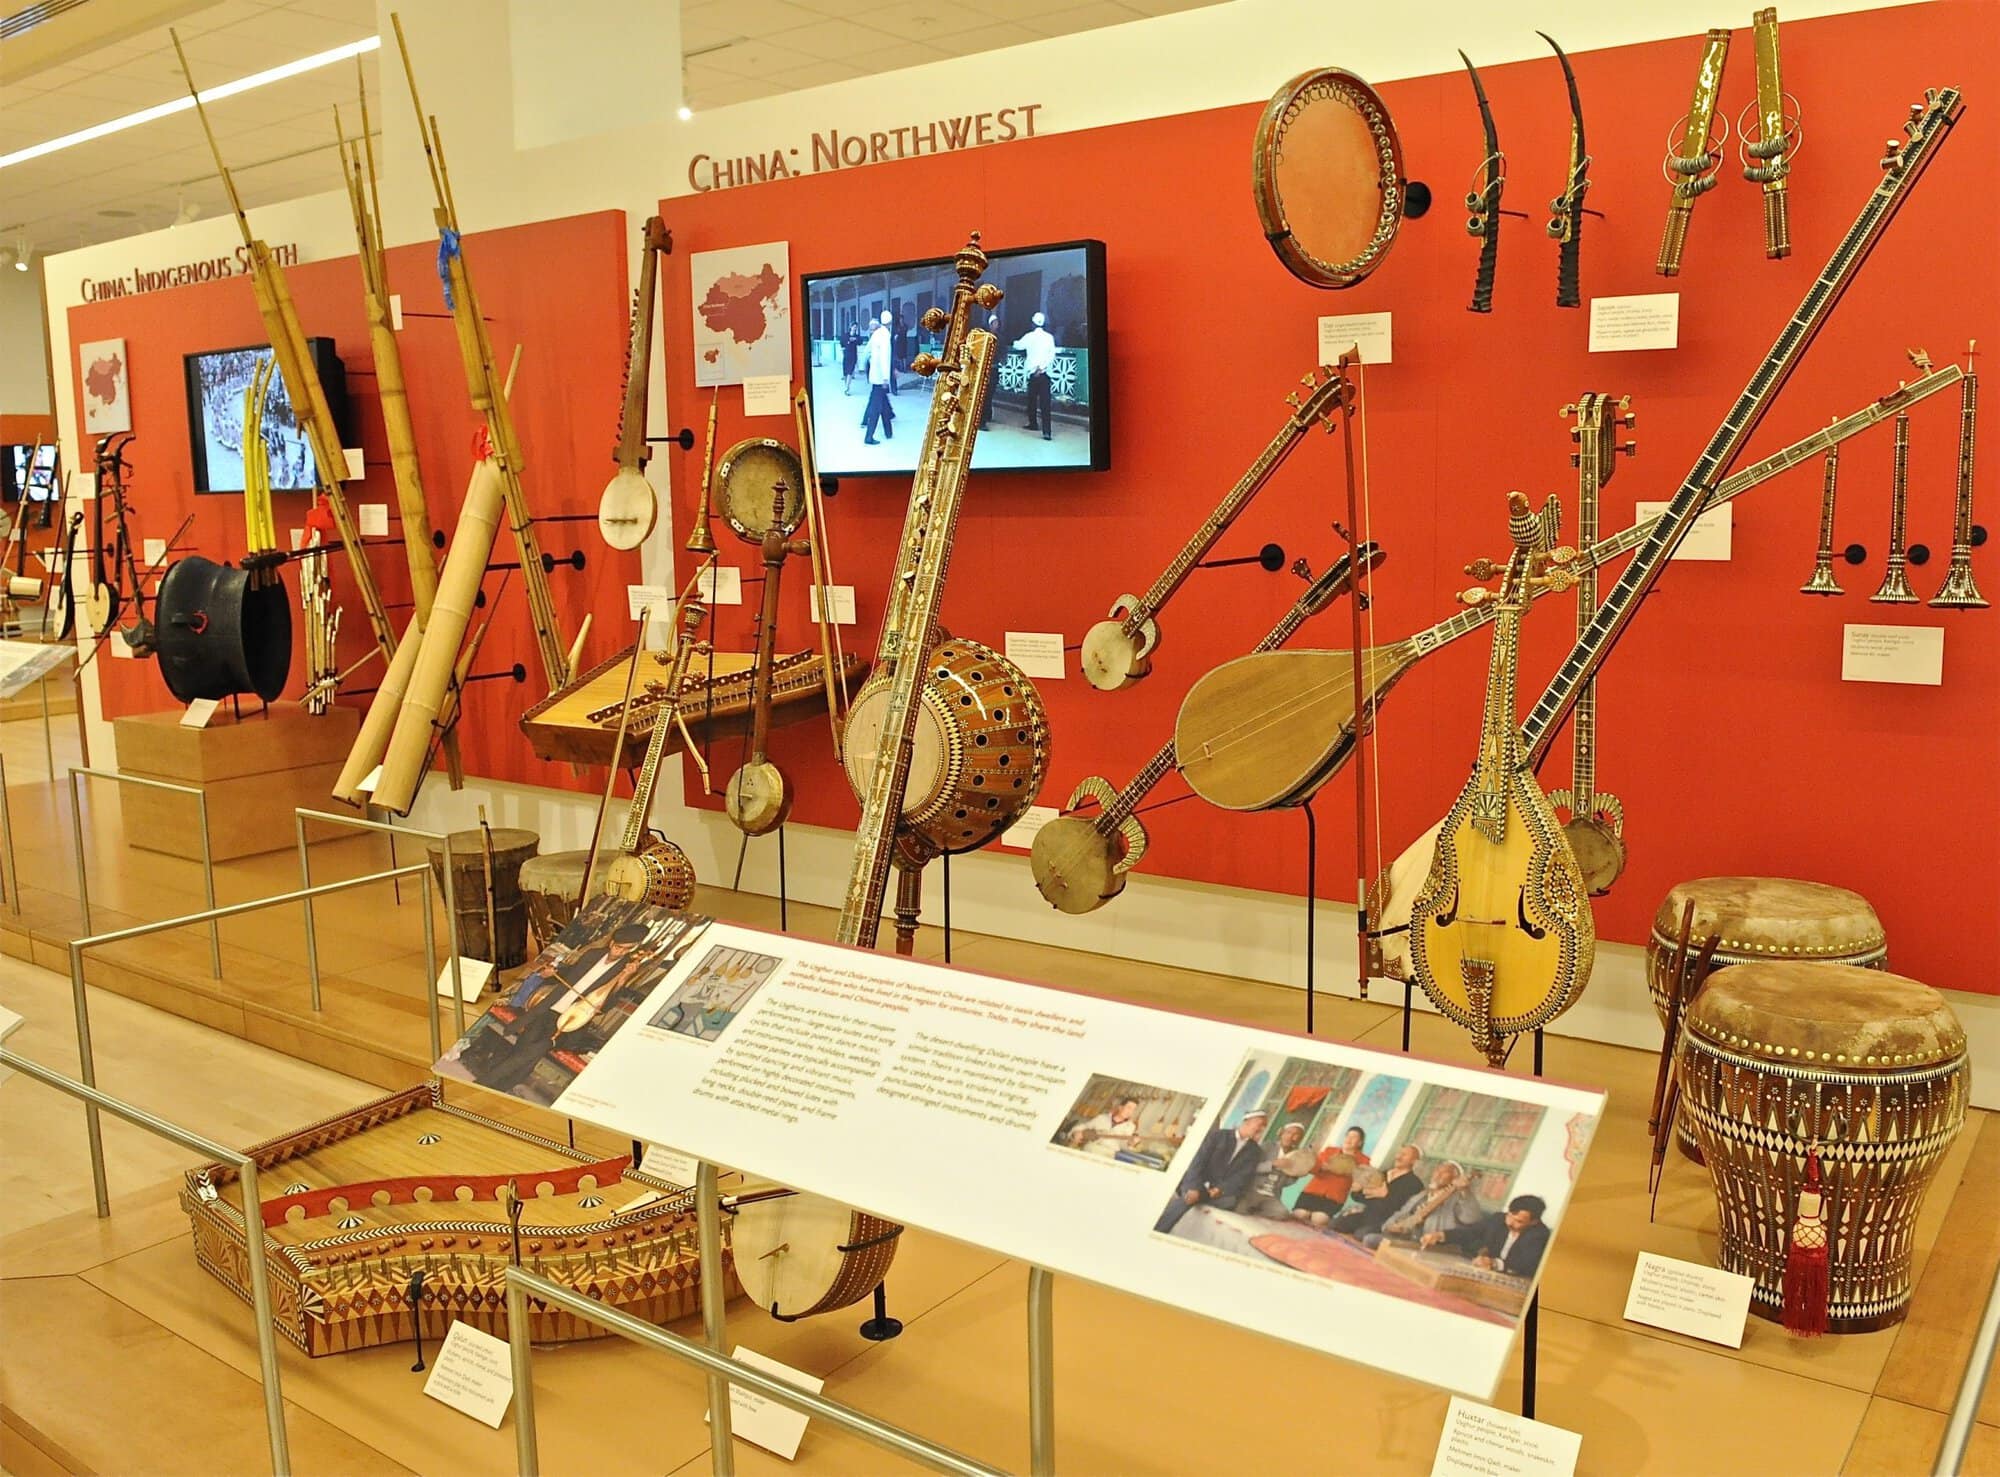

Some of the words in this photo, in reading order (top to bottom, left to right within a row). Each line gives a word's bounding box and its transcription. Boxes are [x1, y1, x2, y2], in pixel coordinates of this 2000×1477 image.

[688, 147, 801, 193] CHINA:
[810, 103, 1043, 172] NORTHWEST
[81, 276, 133, 303] CHINA:
[134, 256, 232, 293] INDIGENOUS
[235, 243, 298, 274] STH
[789, 972, 816, 980] nomadic
[818, 977, 842, 986] herders
[859, 984, 874, 993] have
[876, 988, 893, 997] lived
[914, 998, 936, 1006] region
[1011, 1018, 1027, 1027] they
[1029, 1021, 1050, 1031] share
[1051, 1026, 1065, 1034] the
[1067, 1029, 1085, 1038] land
[797, 960, 808, 968] The
[810, 965, 832, 973] Uyghur
[847, 971, 867, 980] Dolan
[868, 977, 895, 986] peoples
[905, 984, 942, 995] Northwest
[943, 991, 963, 1000] China
[977, 1000, 1004, 1009] related
[1035, 1011, 1066, 1022] dwellers
[1069, 1018, 1085, 1026] and
[797, 983, 821, 992] Central
[821, 988, 839, 996] Asian
[854, 995, 881, 1006] Chinese
[767, 997, 778, 1006] The
[818, 1010, 840, 1019] known
[852, 1018, 868, 1026] their
[750, 1019, 770, 1027] cycles
[785, 1027, 810, 1036] include
[835, 1039, 857, 1048] dance
[756, 1032, 796, 1045] instrumental
[843, 1029, 862, 1038] suites
[878, 1038, 896, 1047] song
[725, 1046, 734, 1054] by
[736, 1050, 762, 1061] spirited
[761, 1057, 789, 1069] dancing
[790, 1064, 805, 1072] and
[805, 1068, 831, 1078] vibrant
[746, 1041, 768, 1050] private
[768, 1047, 791, 1056] parties
[803, 1055, 829, 1066] typically
[830, 1063, 876, 1077] accompanied
[908, 1044, 930, 1053] similar
[933, 1049, 963, 1060] tradition
[964, 1056, 987, 1066] linked
[997, 1064, 1015, 1072] their
[916, 1032, 928, 1040] The
[986, 1048, 1010, 1058] Dolan
[1010, 1056, 1038, 1065] people
[1040, 1061, 1059, 1070] have
[710, 1068, 739, 1081] including
[738, 1076, 766, 1087] plucked
[780, 1086, 804, 1097] bowed
[804, 1092, 821, 1102] lutes
[717, 1058, 752, 1070] performed
[762, 1068, 780, 1079] highly
[781, 1075, 815, 1087] decorated
[892, 1065, 908, 1073] who
[910, 1070, 944, 1082] celebrate
[930, 1060, 952, 1071] Theirs
[963, 1070, 1006, 1084] maintained
[1006, 1078, 1016, 1087] by
[1018, 1081, 1048, 1094] farmers
[692, 1088, 714, 1098] drums
[730, 1099, 760, 1111] attached
[760, 1107, 779, 1117] metal
[702, 1078, 716, 1088] long
[800, 1106, 816, 1114] and
[816, 1108, 837, 1120] frame
[876, 1087, 910, 1099] designed
[910, 1096, 941, 1107] stringed
[942, 1104, 987, 1119] instruments
[988, 1116, 1005, 1124] and
[883, 1076, 926, 1090] punctuated
[926, 1085, 935, 1093] by
[937, 1089, 963, 1100] sounds
[965, 1095, 984, 1104] from
[985, 1100, 1003, 1109] their
[1004, 1107, 1038, 1119] uniquely
[1458, 1410, 1484, 1423] Huxtar
